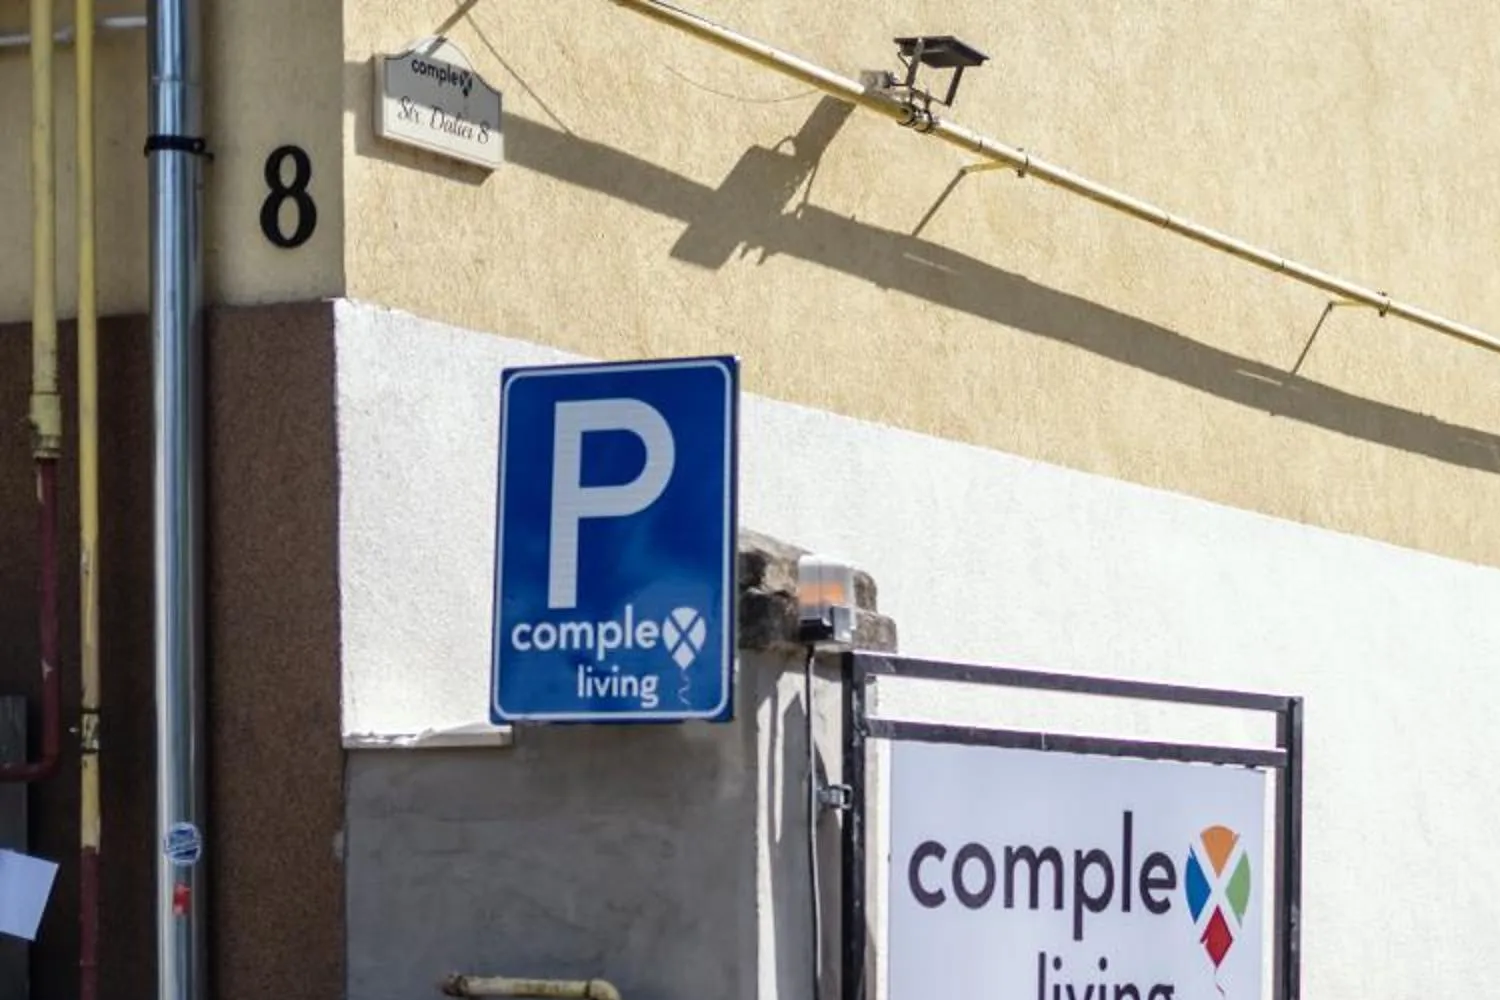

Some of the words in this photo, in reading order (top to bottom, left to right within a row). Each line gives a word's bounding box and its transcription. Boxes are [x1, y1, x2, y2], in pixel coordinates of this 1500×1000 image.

[259, 144, 317, 249] 8
[547, 397, 676, 610] P
[577, 663, 660, 708] living
